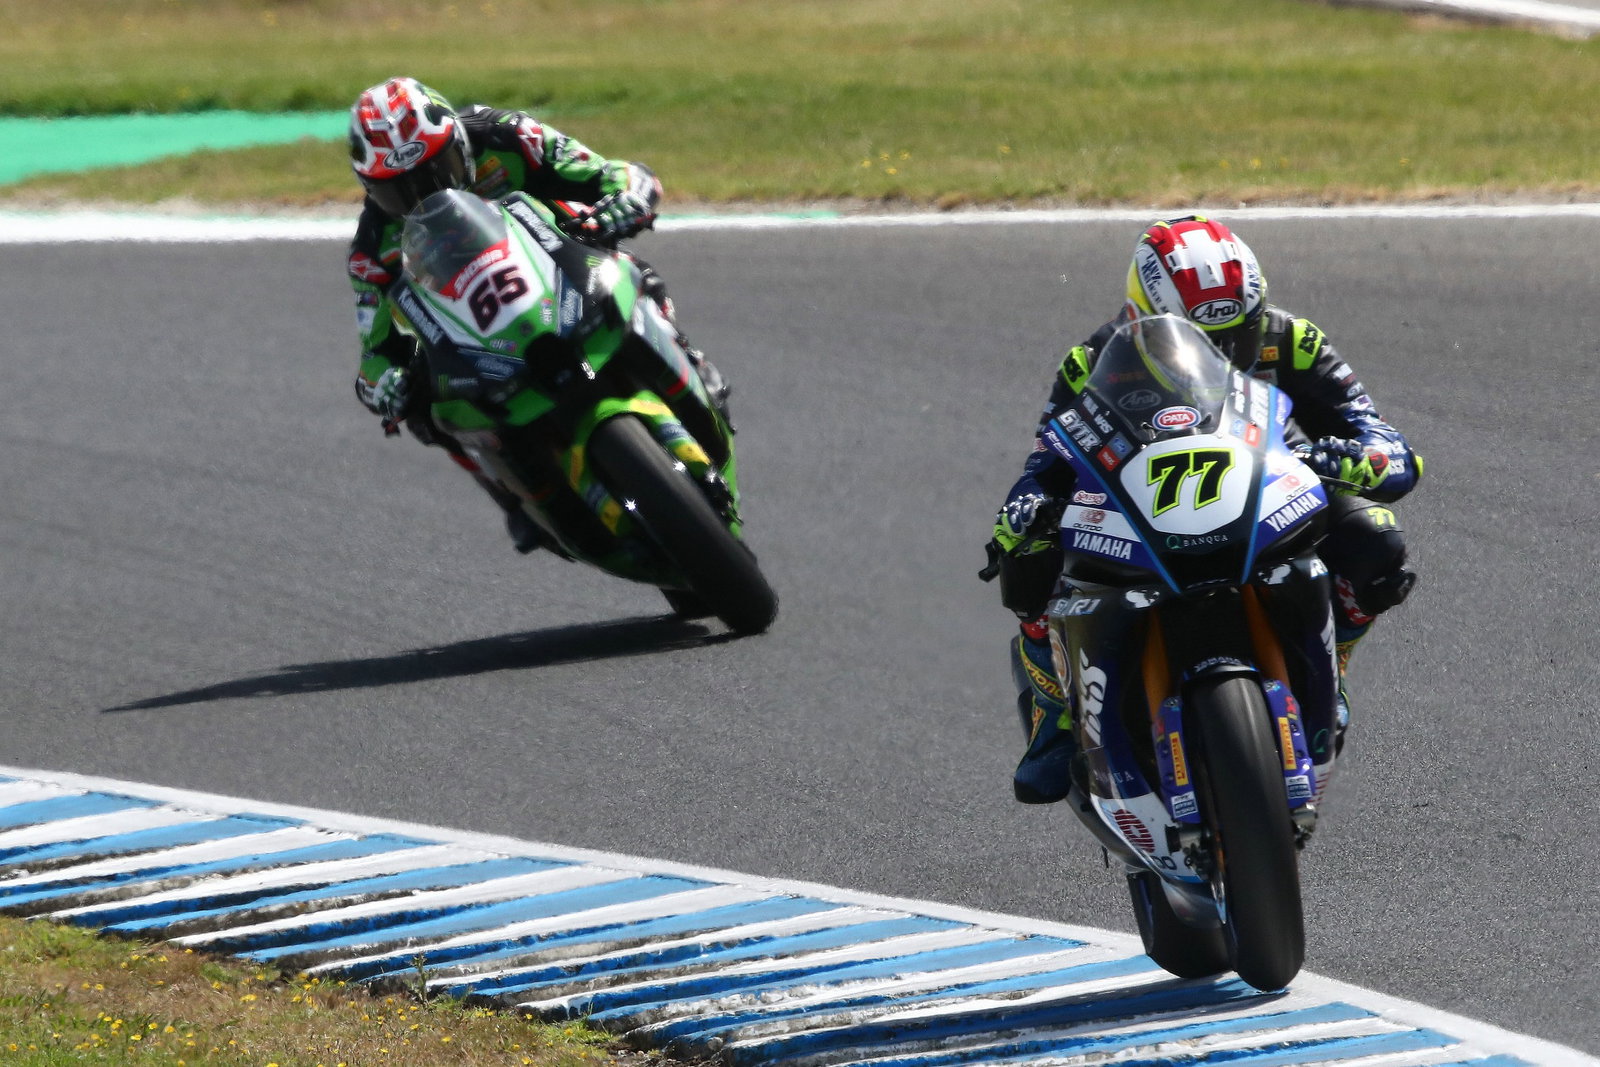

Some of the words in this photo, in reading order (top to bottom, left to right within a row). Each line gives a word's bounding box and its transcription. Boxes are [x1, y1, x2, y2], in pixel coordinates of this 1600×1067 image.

[468, 266, 528, 331] 65
[1195, 303, 1236, 320] Arai
[1057, 408, 1102, 453] GYTR
[1162, 413, 1191, 424] PATA
[1147, 447, 1236, 518] 77
[1265, 491, 1323, 533] YAMAHA
[1366, 506, 1397, 527] 77
[1072, 531, 1133, 560] YAMAHA
[1171, 737, 1187, 780] PIRELLI
